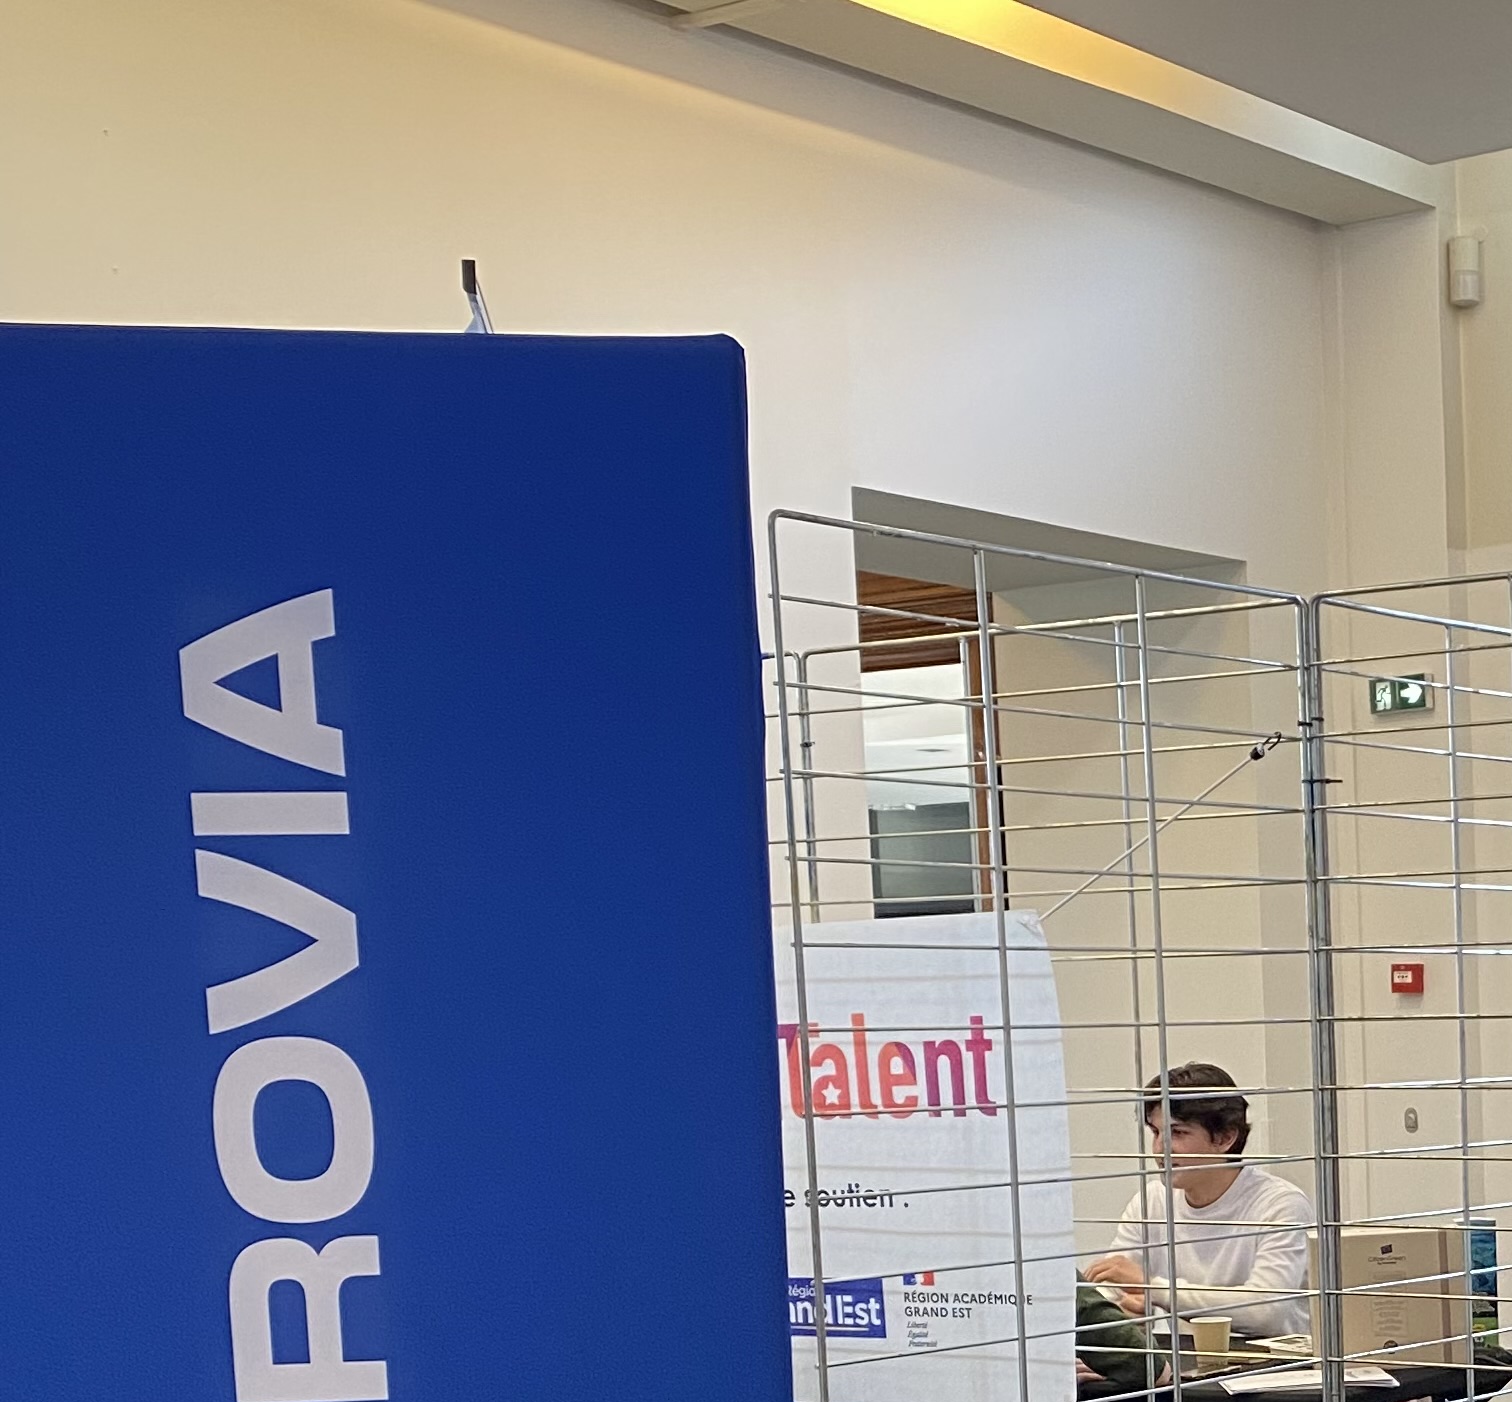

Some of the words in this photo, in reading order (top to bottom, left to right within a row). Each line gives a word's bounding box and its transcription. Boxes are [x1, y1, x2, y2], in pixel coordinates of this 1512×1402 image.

[904, 1290, 949, 1304] RÉGION
[952, 1291, 1033, 1306] ACADÉMIQE
[904, 1306, 949, 1318] GRAND
[952, 1307, 972, 1319] EST
